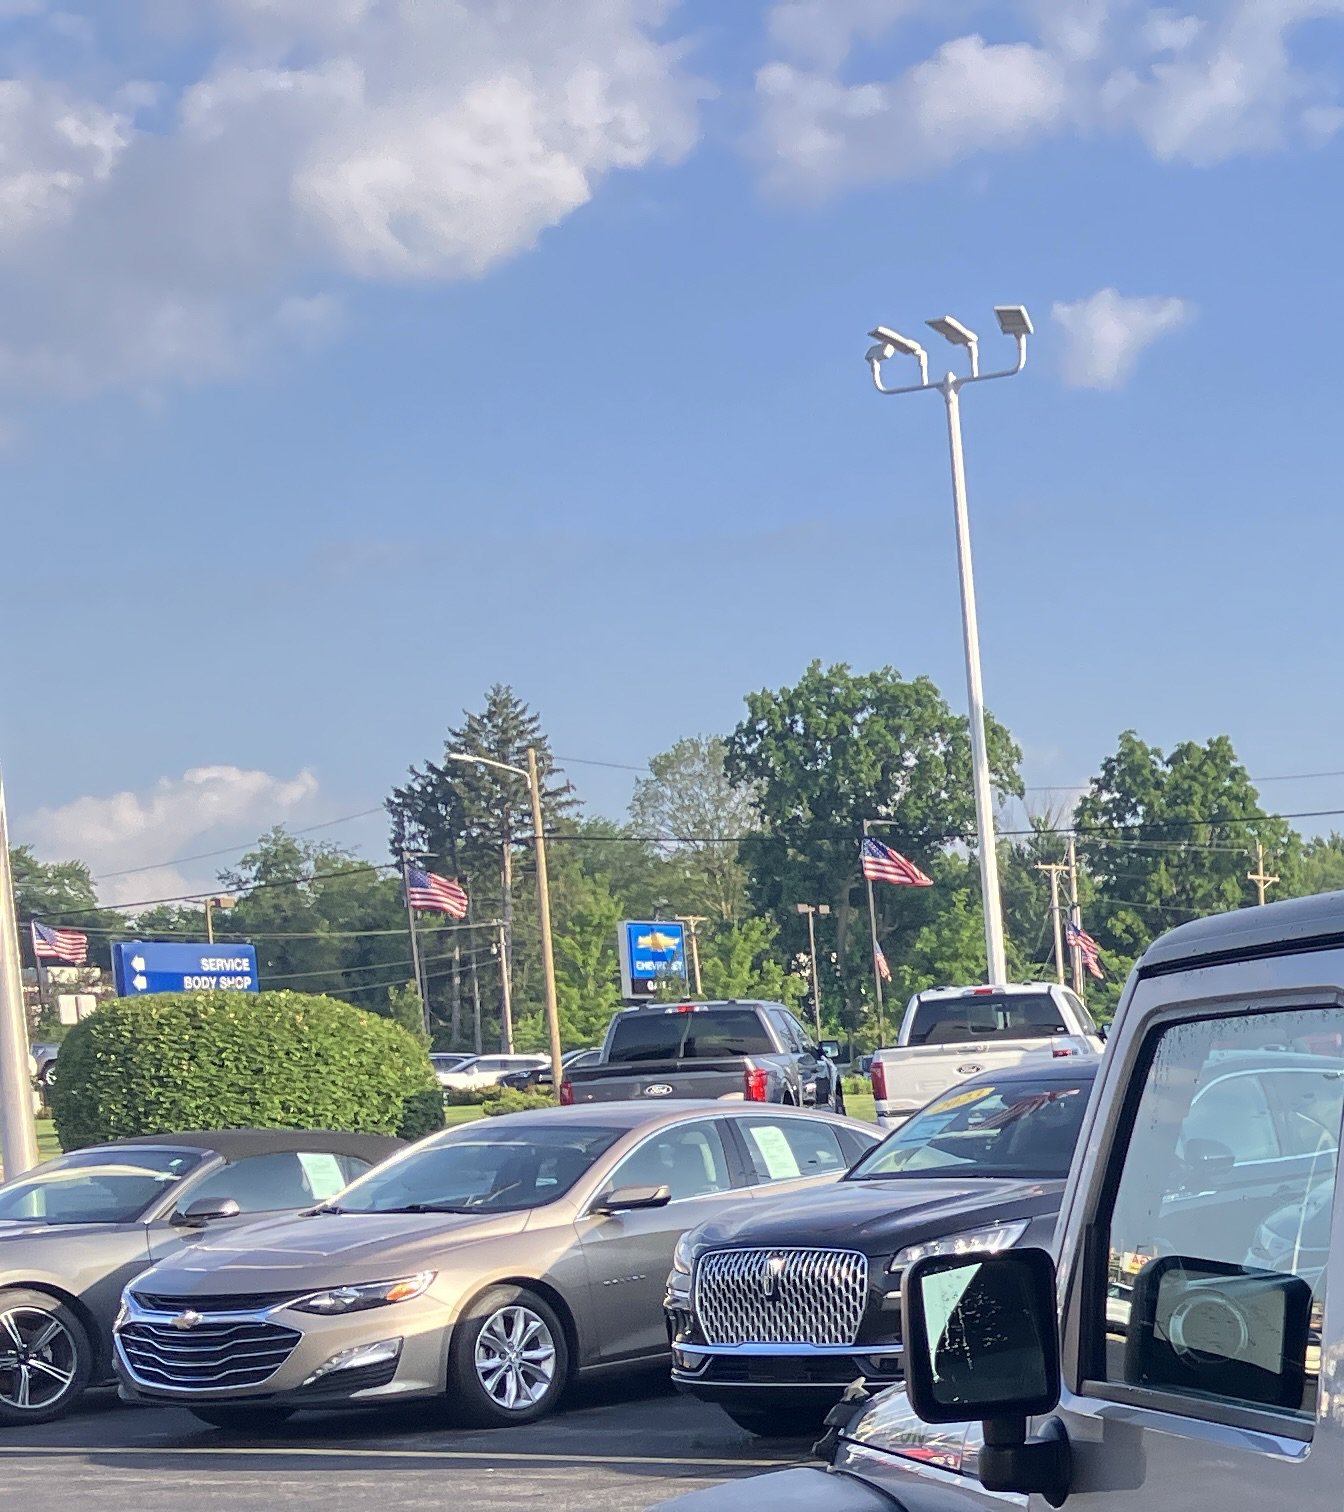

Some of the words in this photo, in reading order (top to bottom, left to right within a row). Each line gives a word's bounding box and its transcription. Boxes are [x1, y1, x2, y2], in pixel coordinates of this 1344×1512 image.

[200, 957, 250, 972] SERVICE
[183, 975, 216, 990] BODY
[219, 975, 252, 990] SHOP
